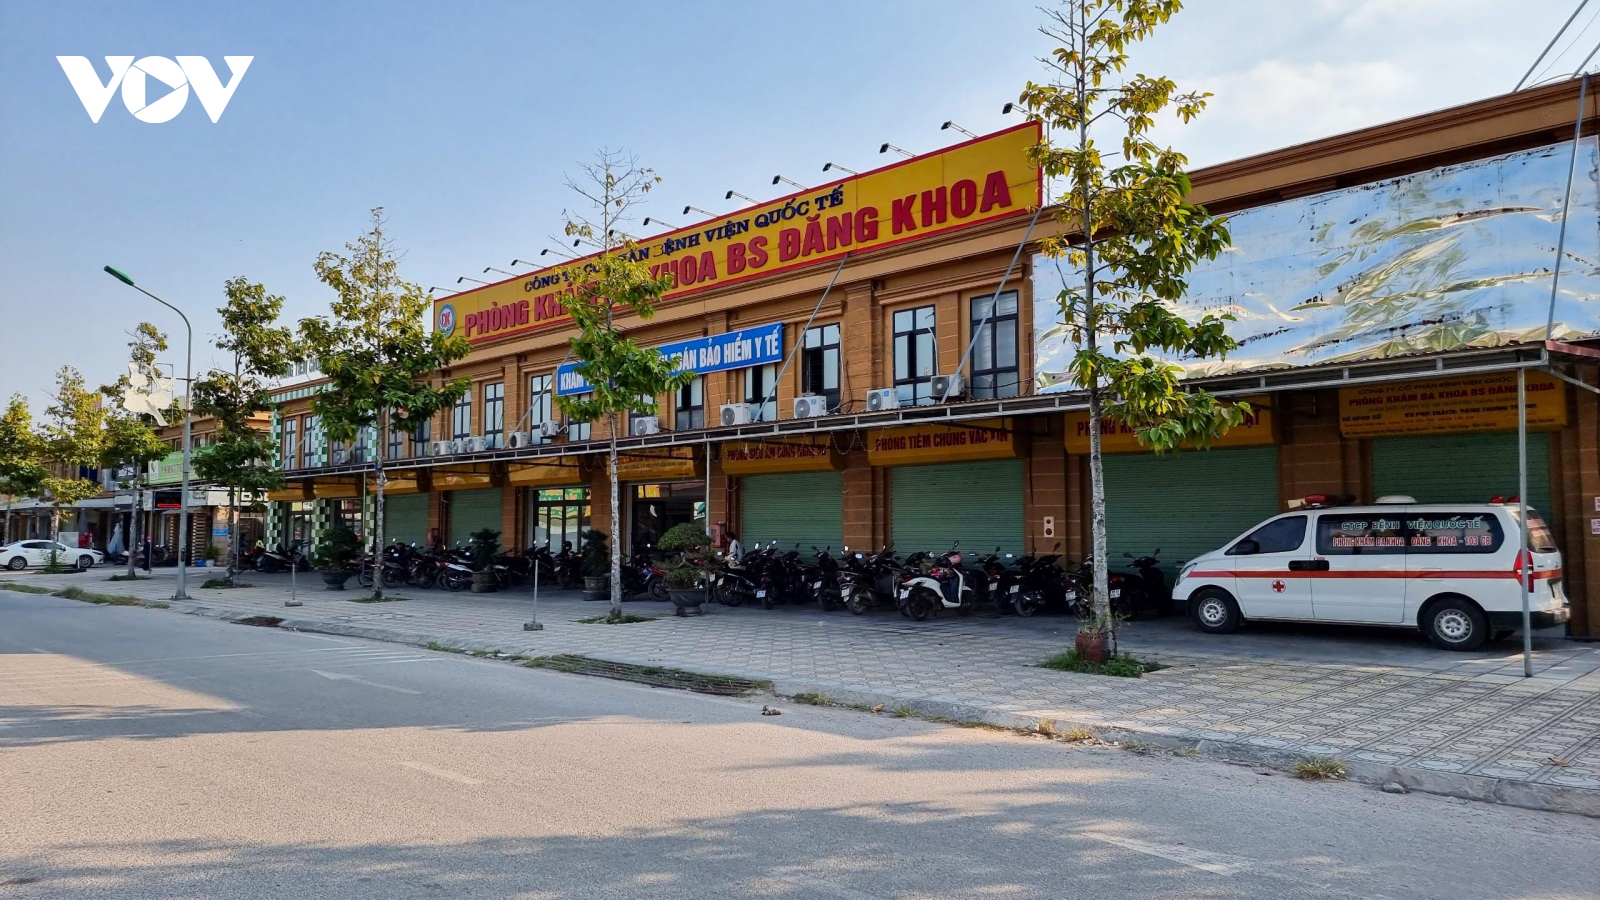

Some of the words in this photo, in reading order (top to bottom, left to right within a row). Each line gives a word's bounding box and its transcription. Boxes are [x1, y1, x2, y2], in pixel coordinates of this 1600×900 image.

[524, 274, 560, 292] CÔNG
[653, 233, 700, 257] BỆNH
[705, 219, 749, 243] VIỆN
[754, 197, 809, 227] QUỐC
[815, 184, 844, 212] TẾ
[465, 301, 530, 337] PHÒNG
[727, 235, 768, 275] BS
[778, 206, 879, 263] ĐĂNG
[891, 170, 1013, 235] KHOA
[700, 338, 721, 368] BẢO
[723, 333, 752, 364] HIỂM
[755, 336, 763, 358] Y
[765, 325, 780, 357] TẾ
[1349, 396, 1384, 406] PHÒNG
[1077, 420, 1116, 437] PHNG
[876, 434, 906, 452] PHÒNG
[933, 427, 967, 447] CHỦNG
[1342, 521, 1368, 531] CTCP
[1372, 518, 1400, 532] BỆNH
[1407, 517, 1432, 532] VIỆN
[1437, 536, 1458, 547] KHOA
